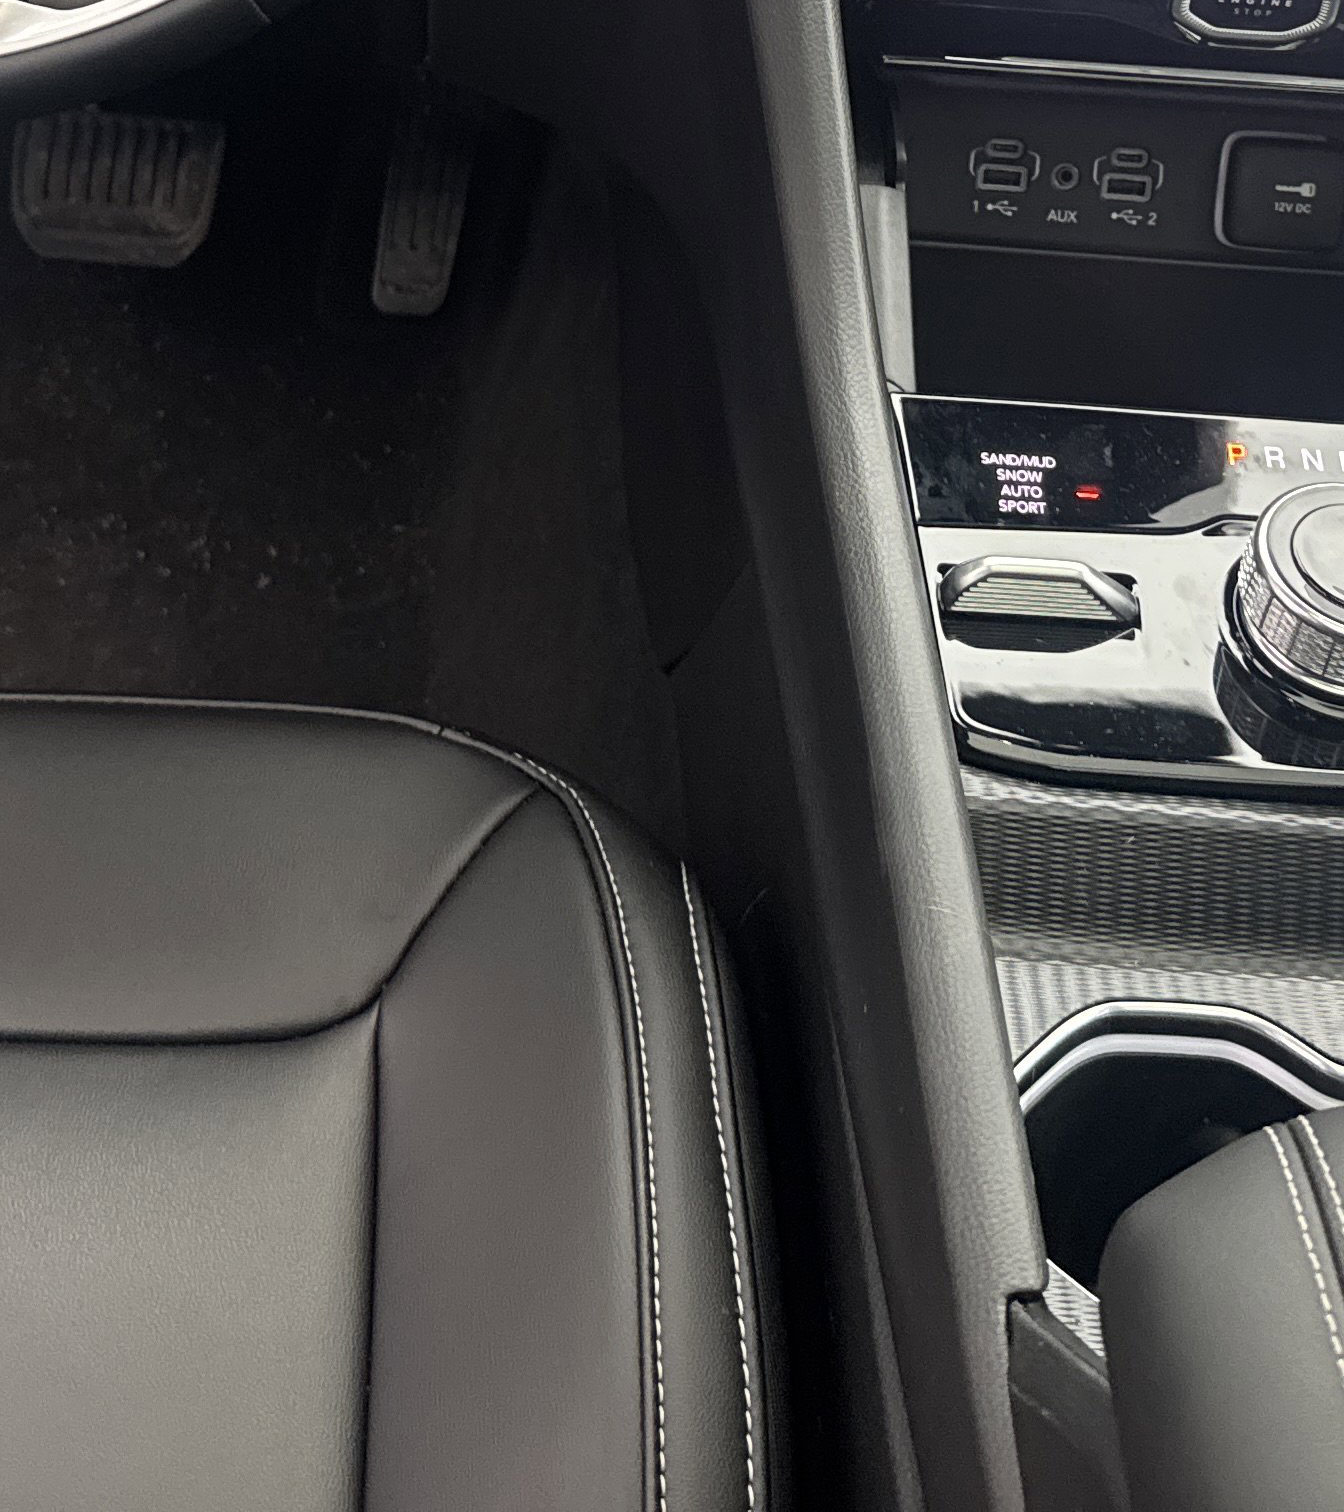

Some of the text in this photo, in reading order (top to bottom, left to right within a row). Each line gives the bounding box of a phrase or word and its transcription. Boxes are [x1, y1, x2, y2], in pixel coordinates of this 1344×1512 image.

[1234, 7, 1273, 17] STOP
[973, 200, 979, 213] 1
[1274, 202, 1311, 214] 12V DC
[1046, 209, 1078, 224] AUX
[1147, 213, 1157, 226] 2
[980, 451, 1056, 468] SAND/MUD
[1227, 442, 1247, 466] P
[1264, 445, 1286, 469] R
[1301, 447, 1325, 472] N
[996, 468, 1043, 483] SNOW
[1001, 484, 1043, 499] AUTO
[998, 499, 1046, 515] SPORT
